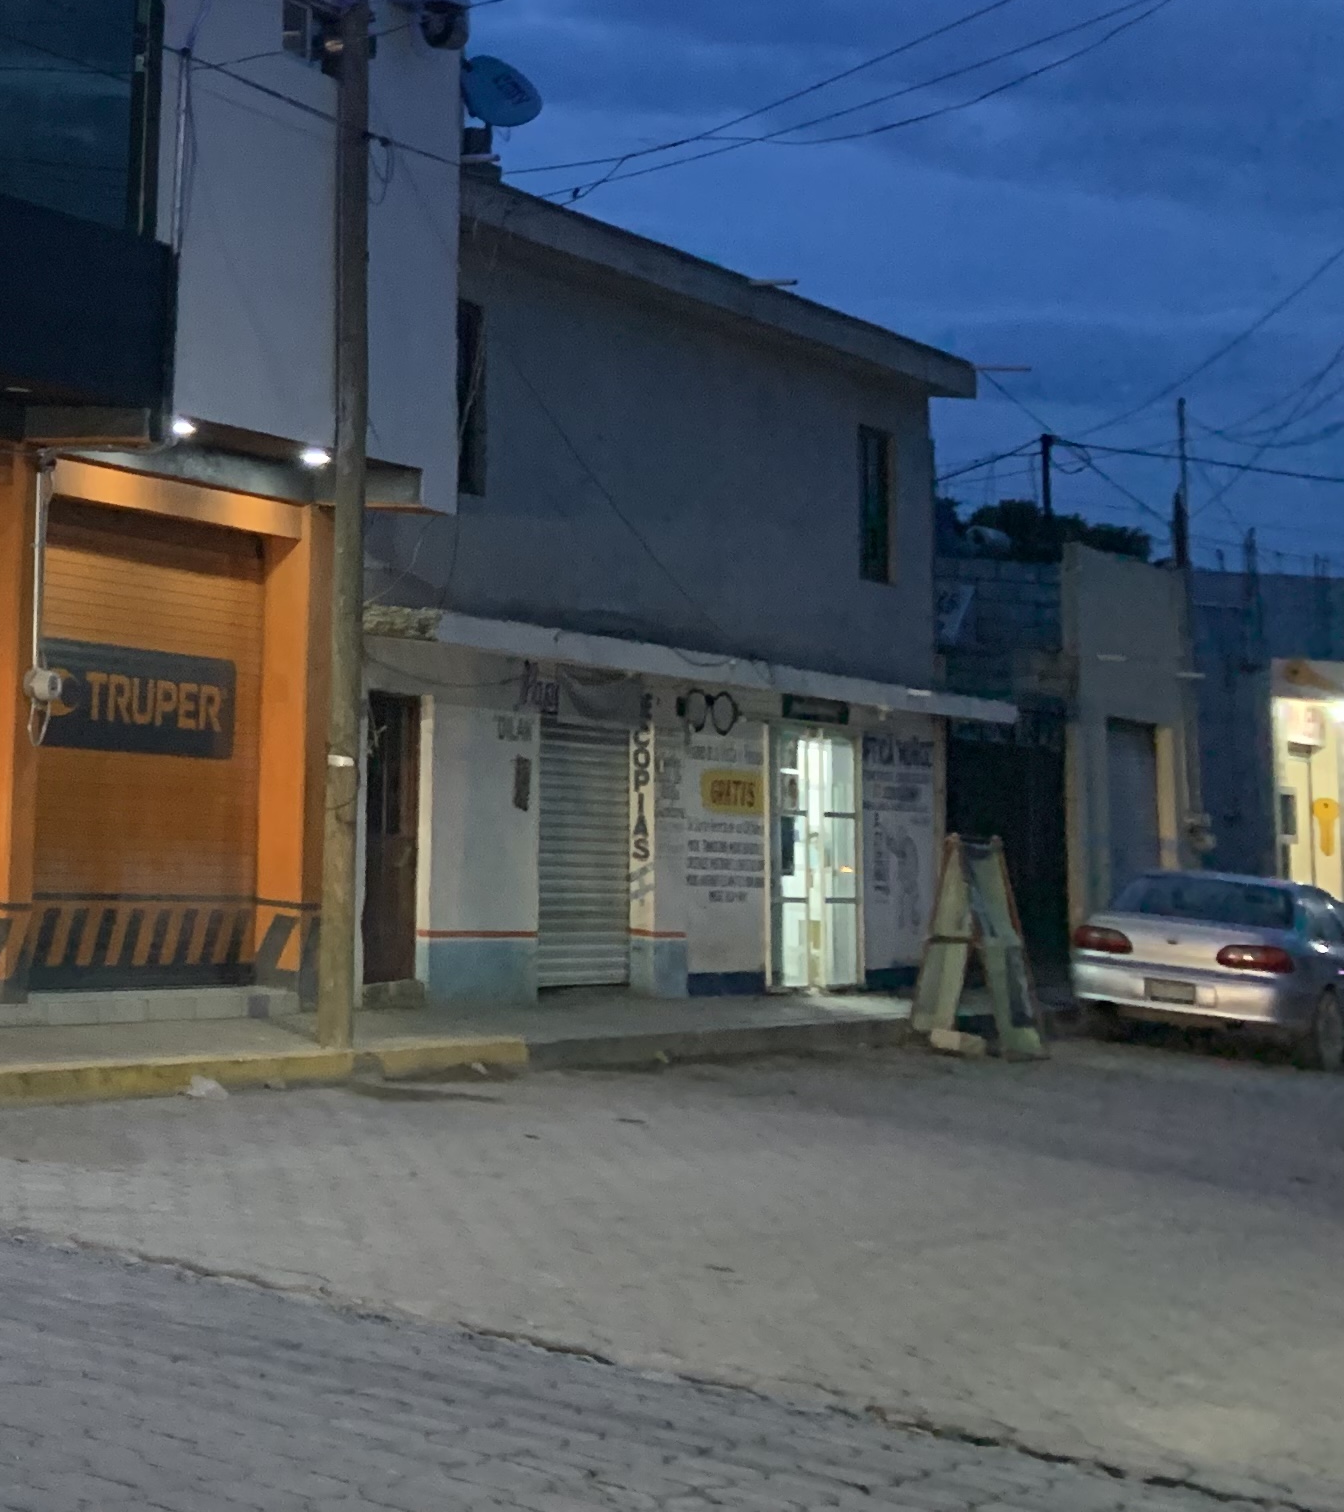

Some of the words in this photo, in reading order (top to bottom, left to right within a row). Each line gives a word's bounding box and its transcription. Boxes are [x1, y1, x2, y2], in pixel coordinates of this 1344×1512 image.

[85, 670, 223, 733] TRUPER
[631, 724, 652, 862] COPIAS
[709, 779, 756, 809] GRATIS
